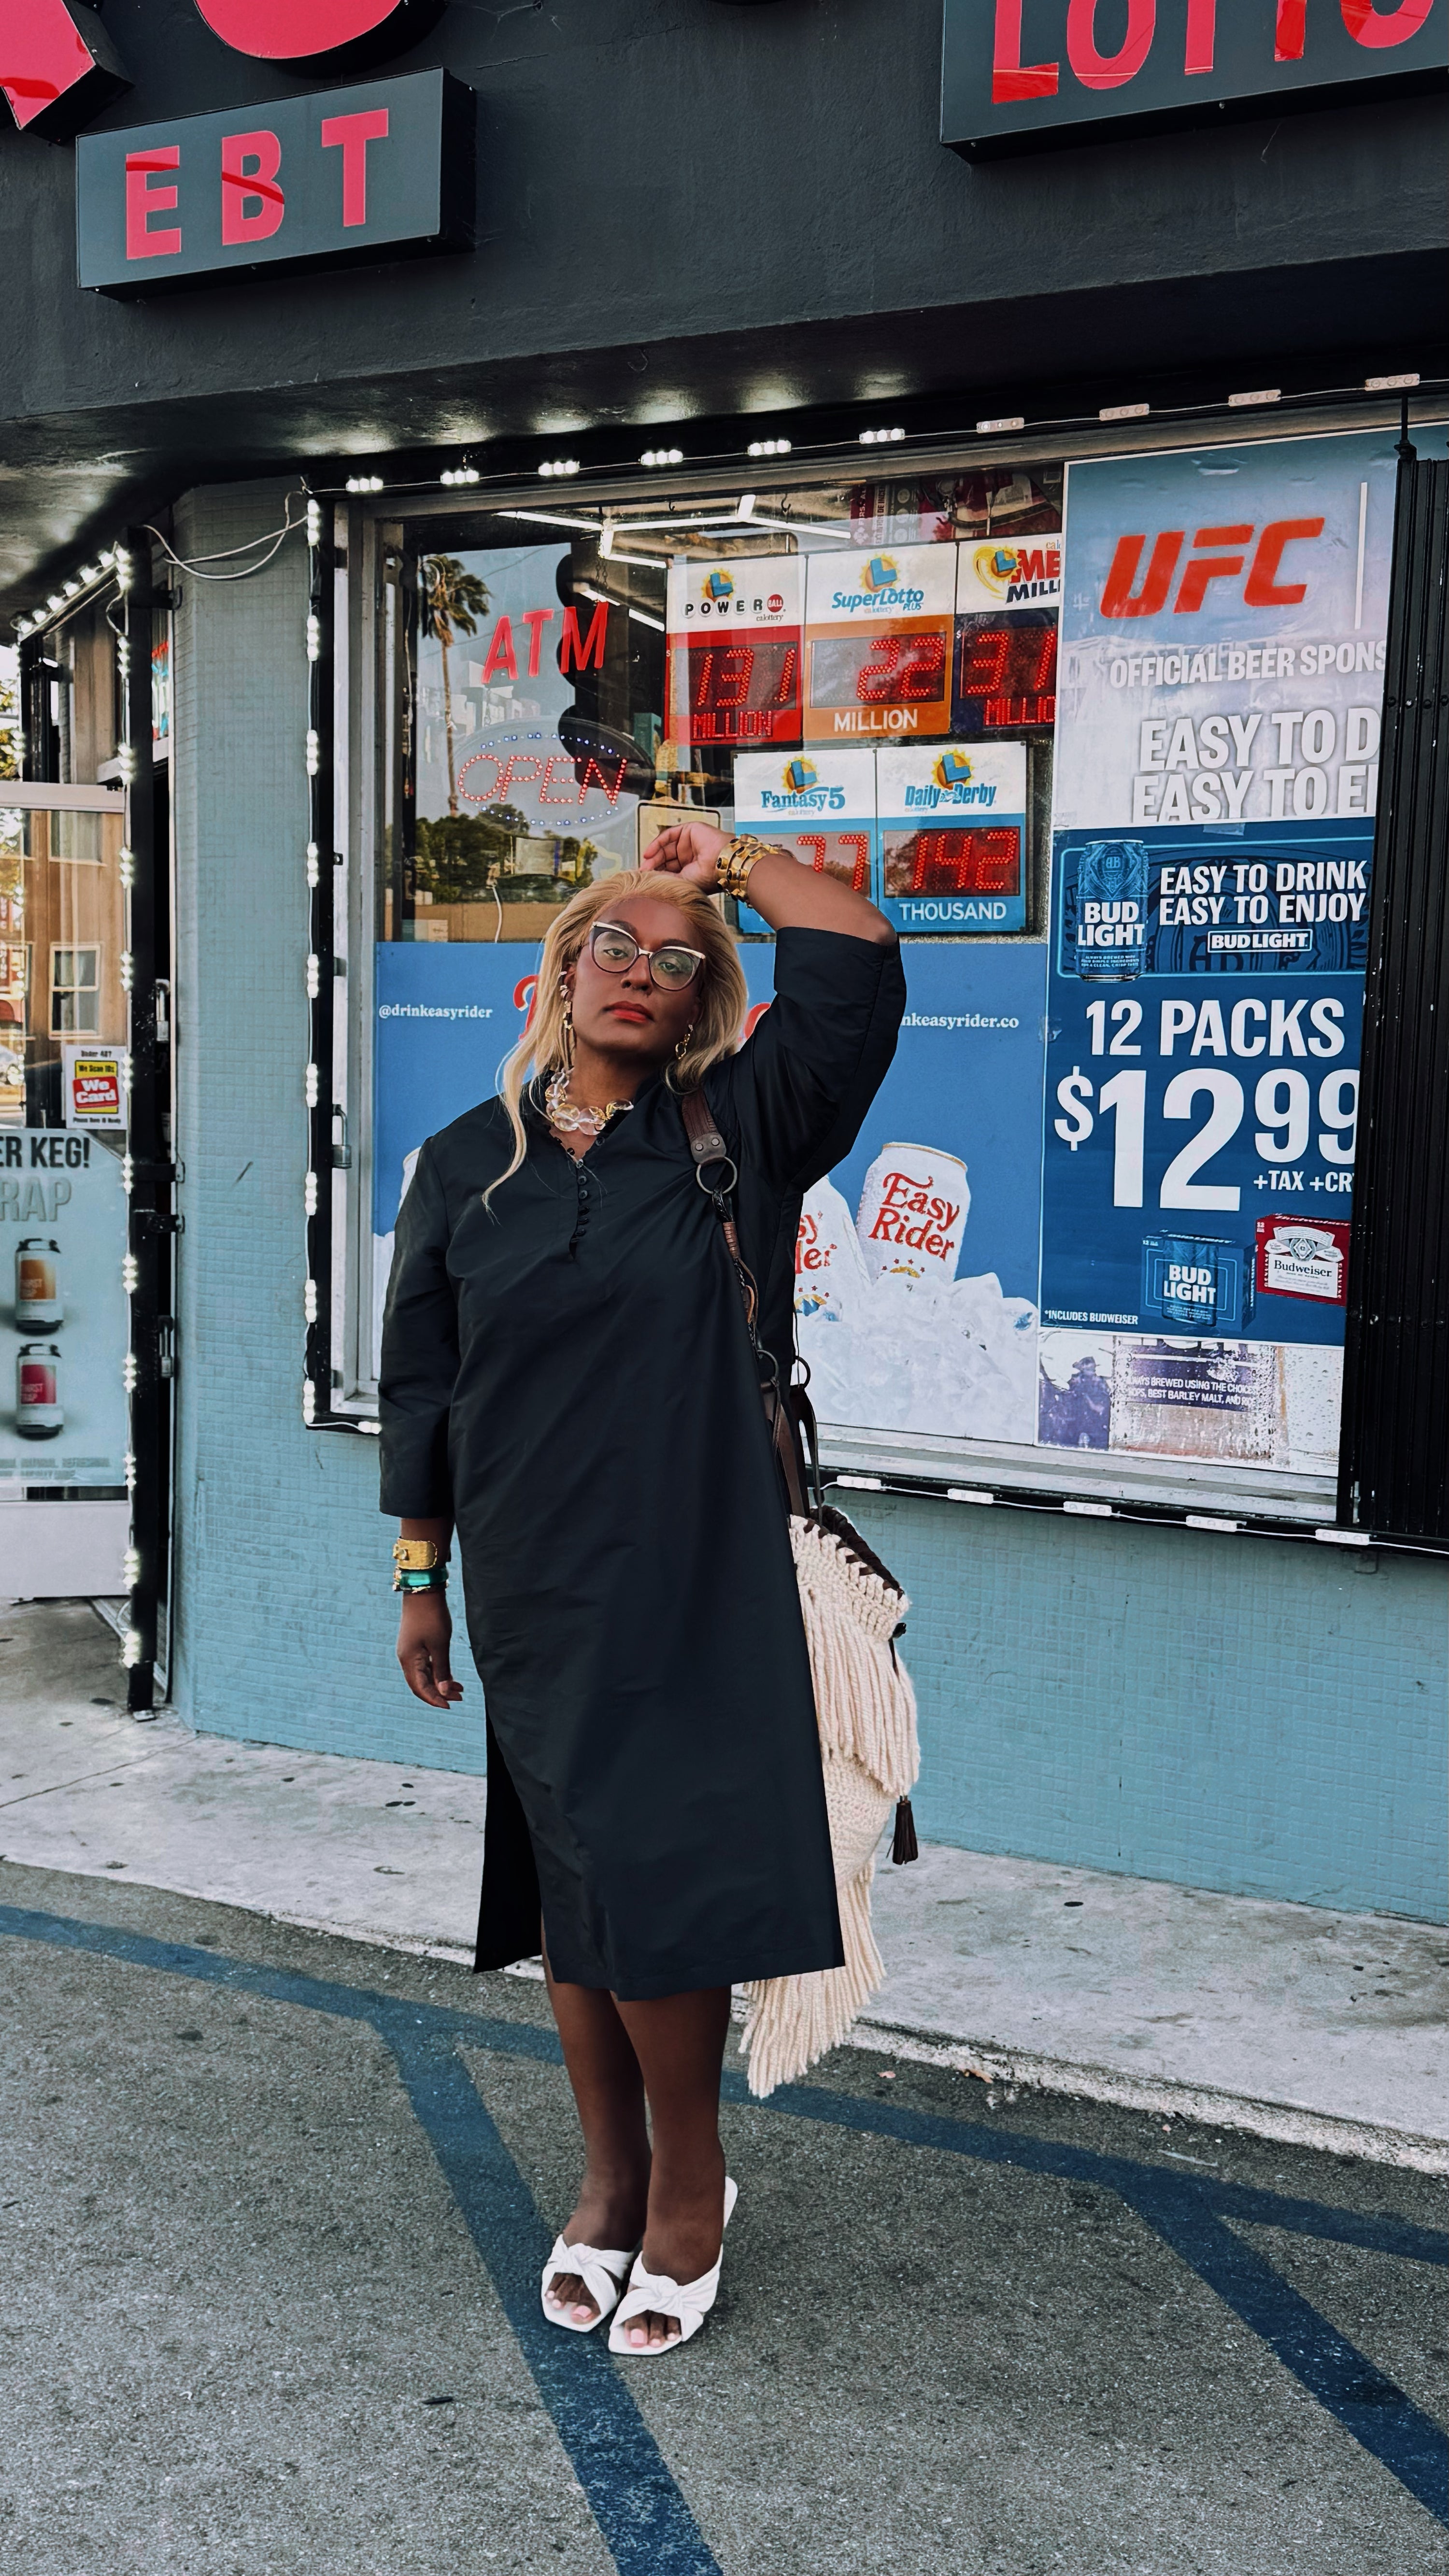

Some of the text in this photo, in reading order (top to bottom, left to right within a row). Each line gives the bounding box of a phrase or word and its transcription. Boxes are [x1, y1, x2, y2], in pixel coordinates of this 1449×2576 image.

[126, 108, 388, 260] EBT
[1099, 517, 1325, 618] UFC
[832, 588, 924, 612] SuperLotto
[903, 603, 923, 611] PLUS
[482, 602, 609, 684] ATM
[857, 636, 944, 700] 22
[967, 631, 1056, 695] 31
[1109, 654, 1222, 688] OFFICIAL
[1228, 648, 1293, 681] BEER
[697, 649, 796, 707] 131
[693, 711, 772, 739] MILLION
[834, 709, 918, 732] MILLION
[1139, 714, 1262, 772] EASY
[1271, 710, 1335, 765] TO
[458, 754, 627, 805] OPEN
[761, 787, 846, 811] Fantasy 5
[905, 783, 997, 809] Daily Derby
[1133, 765, 1377, 823] EASY TO E
[913, 830, 1017, 890] 142
[1160, 860, 1367, 895] EASY TO DRINK
[899, 902, 1007, 921] THOUSAND
[1085, 902, 1139, 923] BUD
[1159, 893, 1366, 926] EASY TO ENJOY
[1078, 924, 1145, 946] LIGHT
[1211, 933, 1308, 949] BUD LIGHT
[379, 1004, 493, 1020] @drinkeasyrider
[1087, 998, 1345, 1057] 12 PACKS
[76, 1089, 117, 1104] Card
[81, 1079, 110, 1092] We
[0, 1136, 90, 1168] R KEG!
[1253, 1170, 1354, 1192] +TAX +CR
[882, 1172, 960, 1233] Easy
[868, 1208, 954, 1262] Rider
[1169, 1265, 1211, 1285] BUD
[1274, 1260, 1332, 1277] Budweiser
[1164, 1281, 1216, 1304] LIGHT
[1090, 1312, 1138, 1324] BUDWEISER
[1148, 1390, 1167, 1399] BEST
[1168, 1391, 1200, 1401] BARLEY
[1202, 1394, 1224, 1404] MALT,
[1225, 1395, 1240, 1406] AND
[1151, 1377, 1183, 1388] BREWED
[1185, 1380, 1210, 1390] USING
[1211, 1381, 1227, 1393] THE
